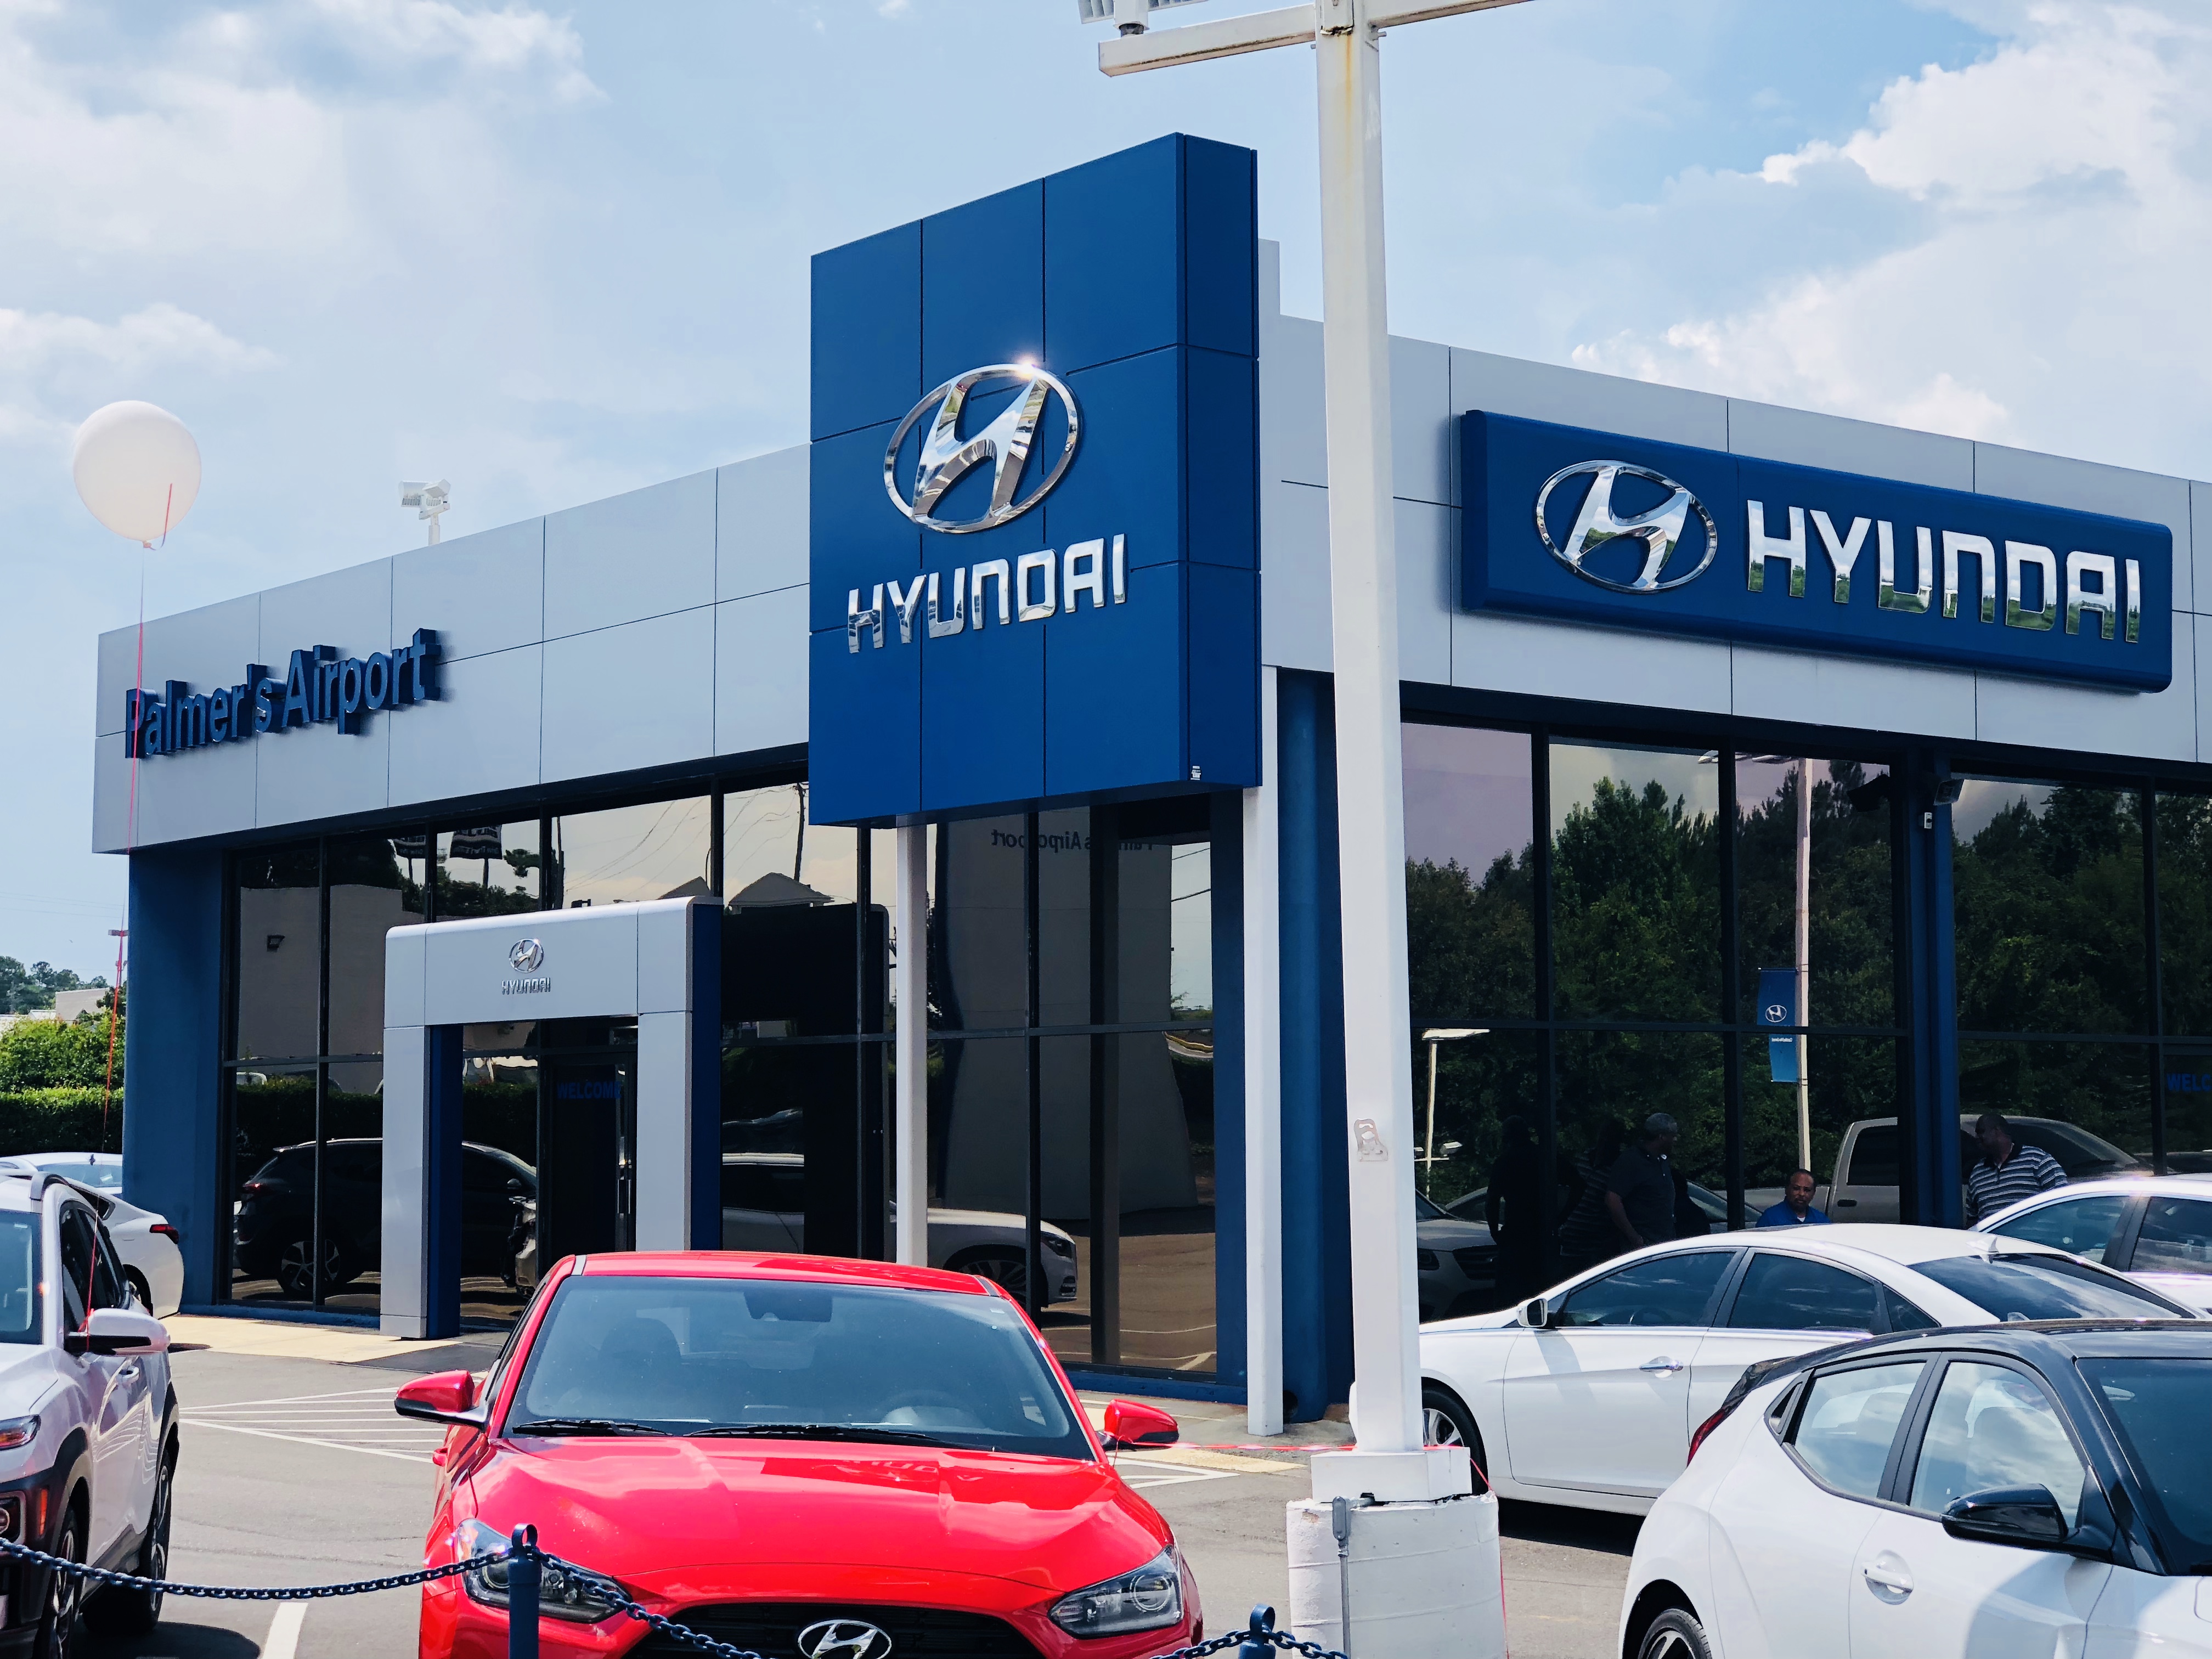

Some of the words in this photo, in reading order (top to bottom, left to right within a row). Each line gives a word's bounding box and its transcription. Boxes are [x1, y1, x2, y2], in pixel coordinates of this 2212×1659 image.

[848, 533, 1126, 653] HYUNDAI
[1747, 499, 2140, 642] HYUNDAI
[126, 664, 283, 758] Palmer's
[282, 628, 441, 735] Airport
[501, 977, 551, 995] HYUNDAI
[557, 1081, 622, 1099] WELCOME
